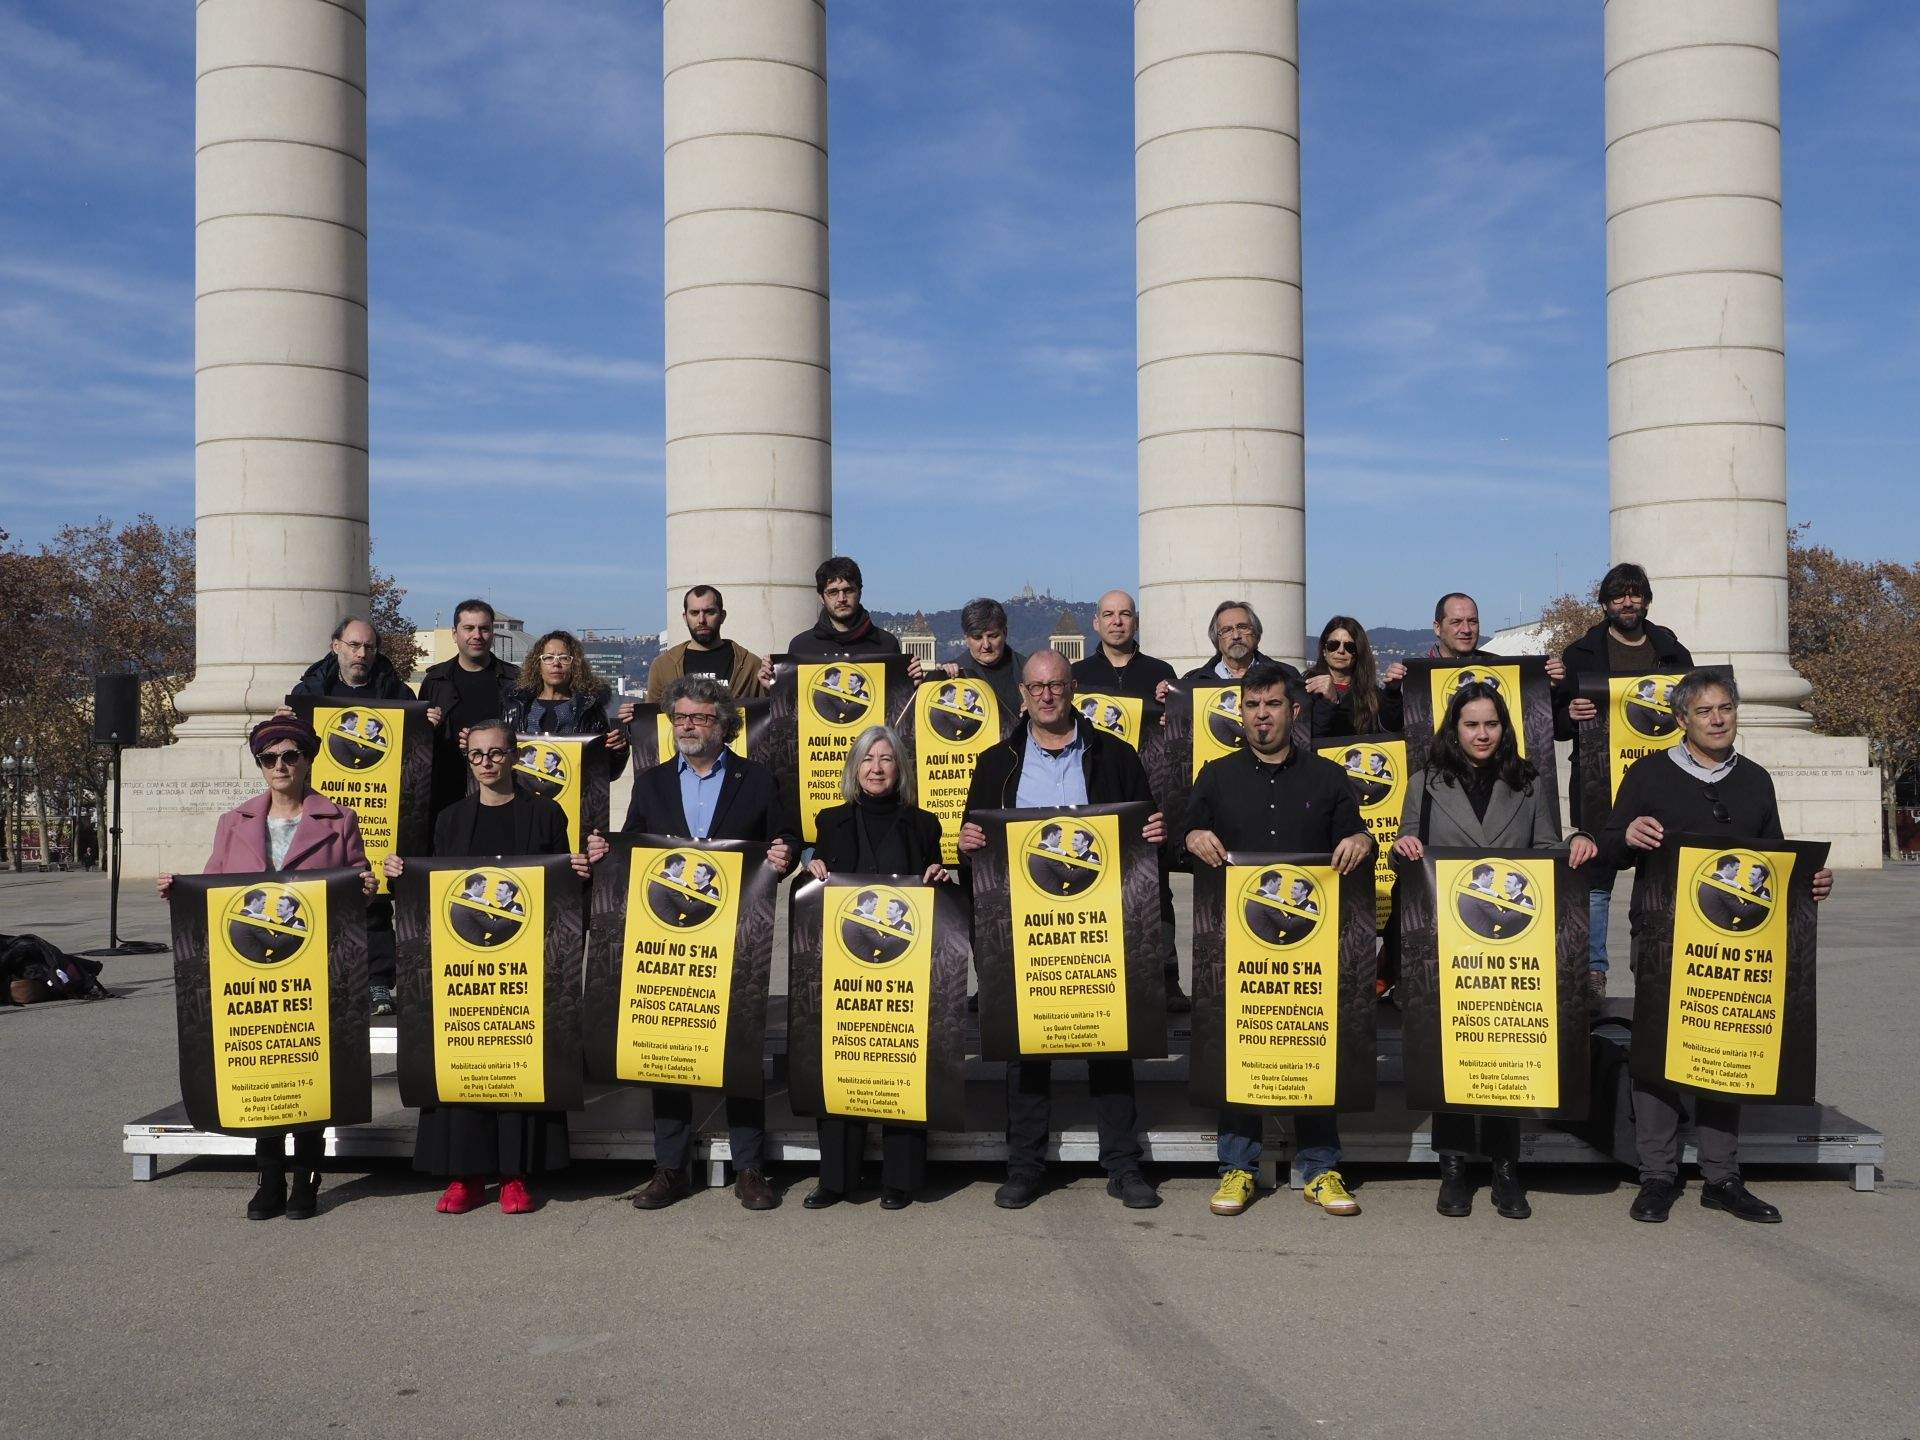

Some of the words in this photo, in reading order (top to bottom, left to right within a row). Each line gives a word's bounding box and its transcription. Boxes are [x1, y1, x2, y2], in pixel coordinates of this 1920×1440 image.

[808, 734, 831, 747] AQUÍ
[834, 737, 847, 746] NO
[810, 752, 848, 761] ACABAT
[926, 752, 949, 765] AQUÍ
[952, 754, 964, 764] NO
[929, 769, 966, 780] ACABAT
[321, 779, 345, 792] AQUÍ
[348, 782, 361, 792] NO
[365, 782, 387, 793] S'HA
[808, 780, 835, 788] PAÏSOS
[330, 797, 362, 807] CABAT
[365, 798, 386, 808] RES!
[927, 799, 954, 808] PAÏSOS
[1377, 817, 1399, 828] S'HA
[1025, 910, 1054, 927] AQUÍ
[1057, 912, 1074, 925] NO
[1078, 911, 1107, 924] S'HA
[1028, 932, 1076, 946] ACABAT
[1080, 930, 1108, 944] RES!
[636, 939, 667, 955] AQUÍ
[669, 944, 686, 956] NO
[690, 945, 718, 959] S'HA
[1685, 943, 1720, 959] AQUÍ
[1722, 948, 1740, 961] NO
[1745, 949, 1773, 963] S'HA
[1031, 953, 1111, 967] INDEPENDÈNCIA
[1238, 958, 1269, 974] AQUÍ
[1272, 962, 1288, 974] NO
[1293, 962, 1322, 975] S'HA
[1452, 952, 1484, 969] AQUÍ
[1488, 956, 1505, 969] NO
[1510, 957, 1540, 970] S'HA
[444, 960, 474, 977] AQUÍ
[478, 963, 494, 976] NO
[499, 962, 528, 975] S'HA
[637, 961, 686, 975] ACABAT
[689, 965, 716, 978] RES!
[1026, 971, 1062, 981] PAÏSOS
[1065, 968, 1117, 980] CATALANS
[1687, 963, 1740, 981] ACABAT
[1744, 969, 1772, 983] RES!
[224, 978, 254, 996] AQUÍ
[259, 980, 277, 993] NO
[281, 978, 312, 992] S'HA
[447, 983, 496, 996] ACABAT
[500, 982, 528, 994] RES!
[834, 976, 863, 992] AQUÍ
[866, 980, 882, 992] NO
[886, 980, 914, 993] S'HA
[1030, 986, 1056, 996] PROU
[1060, 983, 1115, 995] REPRESSIÓ
[1240, 981, 1290, 994] ACABAT
[1294, 982, 1322, 994] RES!
[1455, 976, 1507, 989] ACABAT
[1511, 977, 1540, 990] RES!
[637, 984, 716, 999] INDEPENDÈNCIA
[1687, 986, 1772, 1004] INDEPENDÈNCIA
[227, 999, 279, 1015] ACABAT
[283, 998, 312, 1012] RES!
[449, 1004, 529, 1016] INDEPENDÈNCIA
[630, 999, 665, 1010] PAÏSOS
[669, 1002, 720, 1014] CATALANS
[836, 998, 883, 1011] ACABAT
[887, 1000, 914, 1012] RES!
[1242, 1004, 1324, 1016] INDEPENDÈNCIA
[1457, 999, 1543, 1012] INDEPENDÈNCIA
[1680, 1000, 1718, 1014] PAÏSOS
[1722, 1006, 1776, 1020] CATALANS
[445, 1021, 480, 1031] PAÏSOS
[484, 1020, 535, 1030] CATALANS
[632, 1014, 658, 1025] PROU
[662, 1016, 716, 1029] REPRESSIÓ
[837, 1021, 914, 1033] INDEPENDÈNCIA
[1237, 1018, 1273, 1030] PAÏSOS
[1276, 1021, 1329, 1031] CATALANS
[1452, 1014, 1490, 1026] PAÏSOS
[1494, 1017, 1549, 1028] CATALANS
[1682, 1015, 1710, 1028] PROU
[1714, 1020, 1772, 1034] REPRESSIÓ
[230, 1022, 315, 1036] INDEPENDÈNCIA
[225, 1040, 262, 1052] PAÏSOS
[266, 1037, 321, 1049] CATALANS
[448, 1037, 474, 1046] PROU
[478, 1033, 532, 1046] REPRESSIÓ
[832, 1035, 866, 1046] PAÏSOS
[869, 1038, 919, 1048] CATALANS
[1239, 1034, 1266, 1045] PROU
[1270, 1035, 1326, 1046] REPRESSIÓ
[1456, 1032, 1484, 1042] PROU
[1488, 1031, 1547, 1044] REPRESSIÓ
[633, 1041, 667, 1050] Mobilització
[670, 1043, 692, 1051] unitària
[694, 1044, 708, 1052] 19-G
[1683, 1041, 1720, 1054] Mobilització
[1723, 1049, 1747, 1057] unitària
[228, 1057, 256, 1067] PROU
[260, 1050, 318, 1065] REPRESSIÓ
[835, 1051, 860, 1061] PROU
[864, 1052, 916, 1063] REPRESSIÓ
[1702, 1057, 1722, 1067] Quatre
[1724, 1061, 1751, 1070] Columnes
[1242, 1061, 1277, 1069] Mobilització
[232, 1082, 269, 1091] Mobilització
[271, 1080, 296, 1088] unitària
